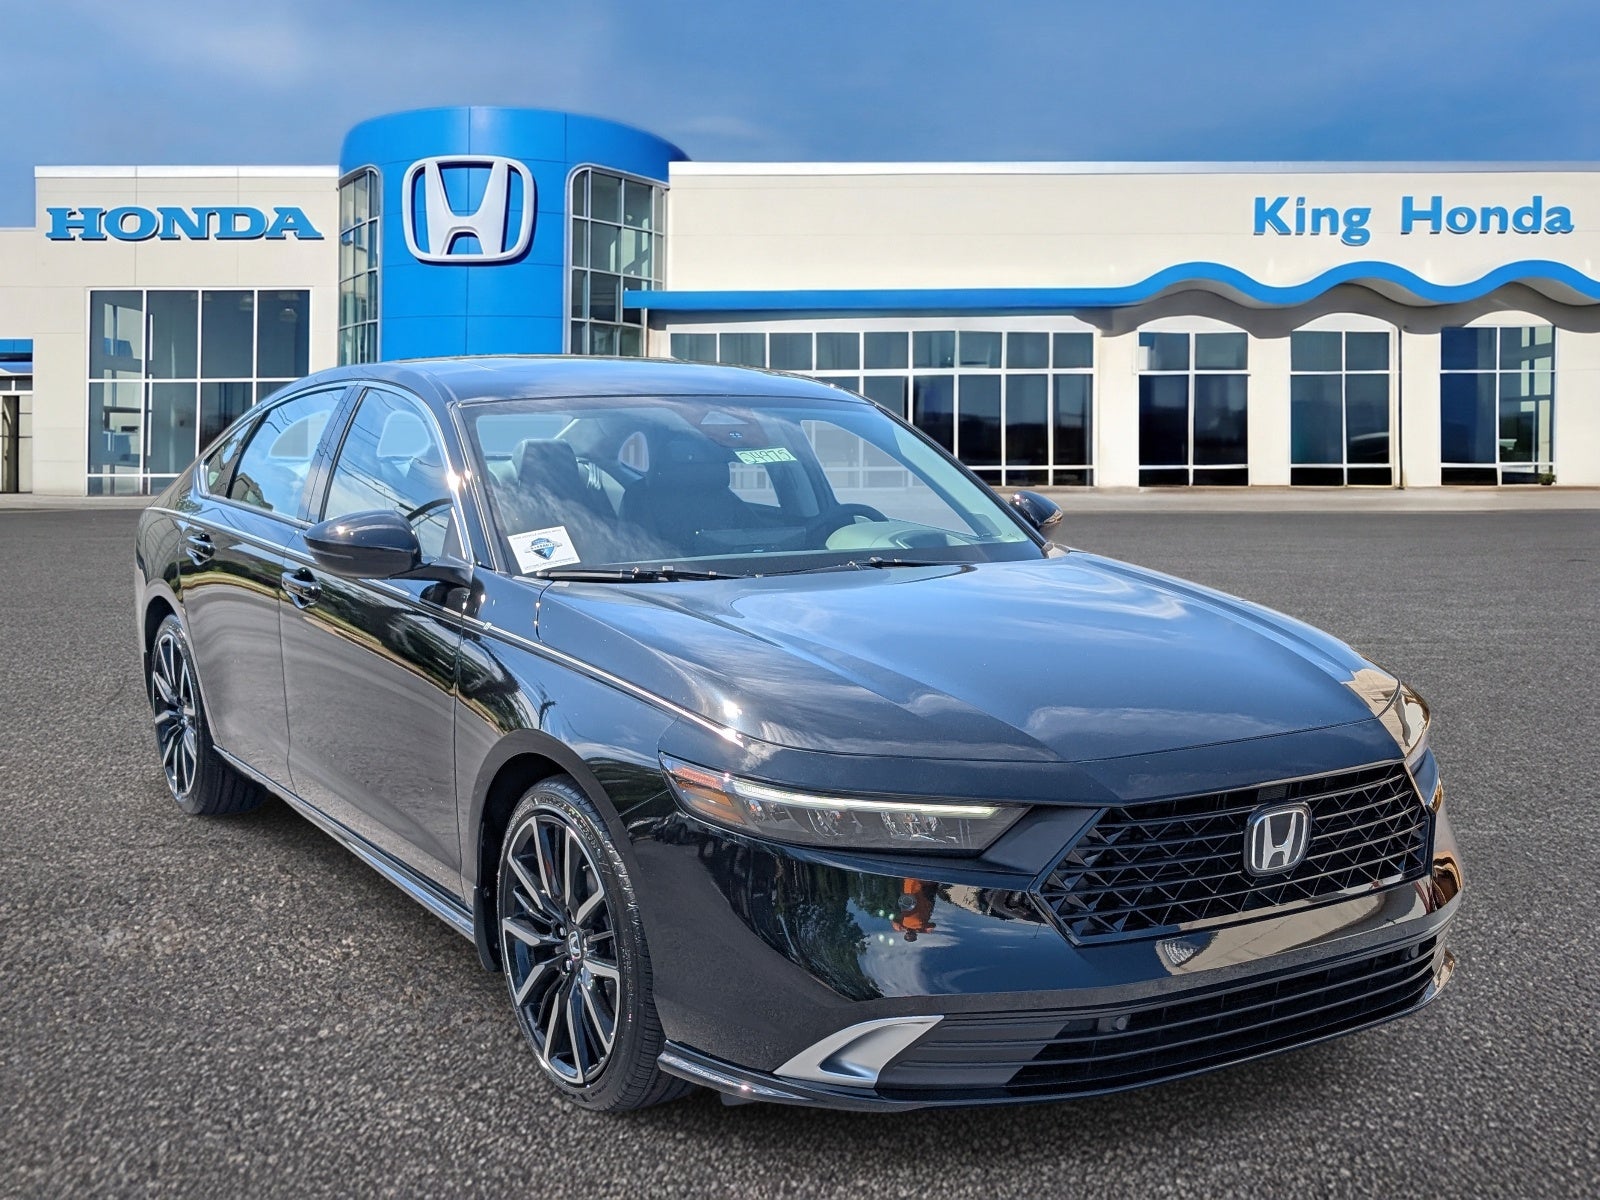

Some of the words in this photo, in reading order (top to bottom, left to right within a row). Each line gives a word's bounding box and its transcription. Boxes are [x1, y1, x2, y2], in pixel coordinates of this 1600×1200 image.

[46, 206, 324, 241] HONDA
[1253, 196, 1372, 246] King
[1400, 195, 1574, 235] Honda
